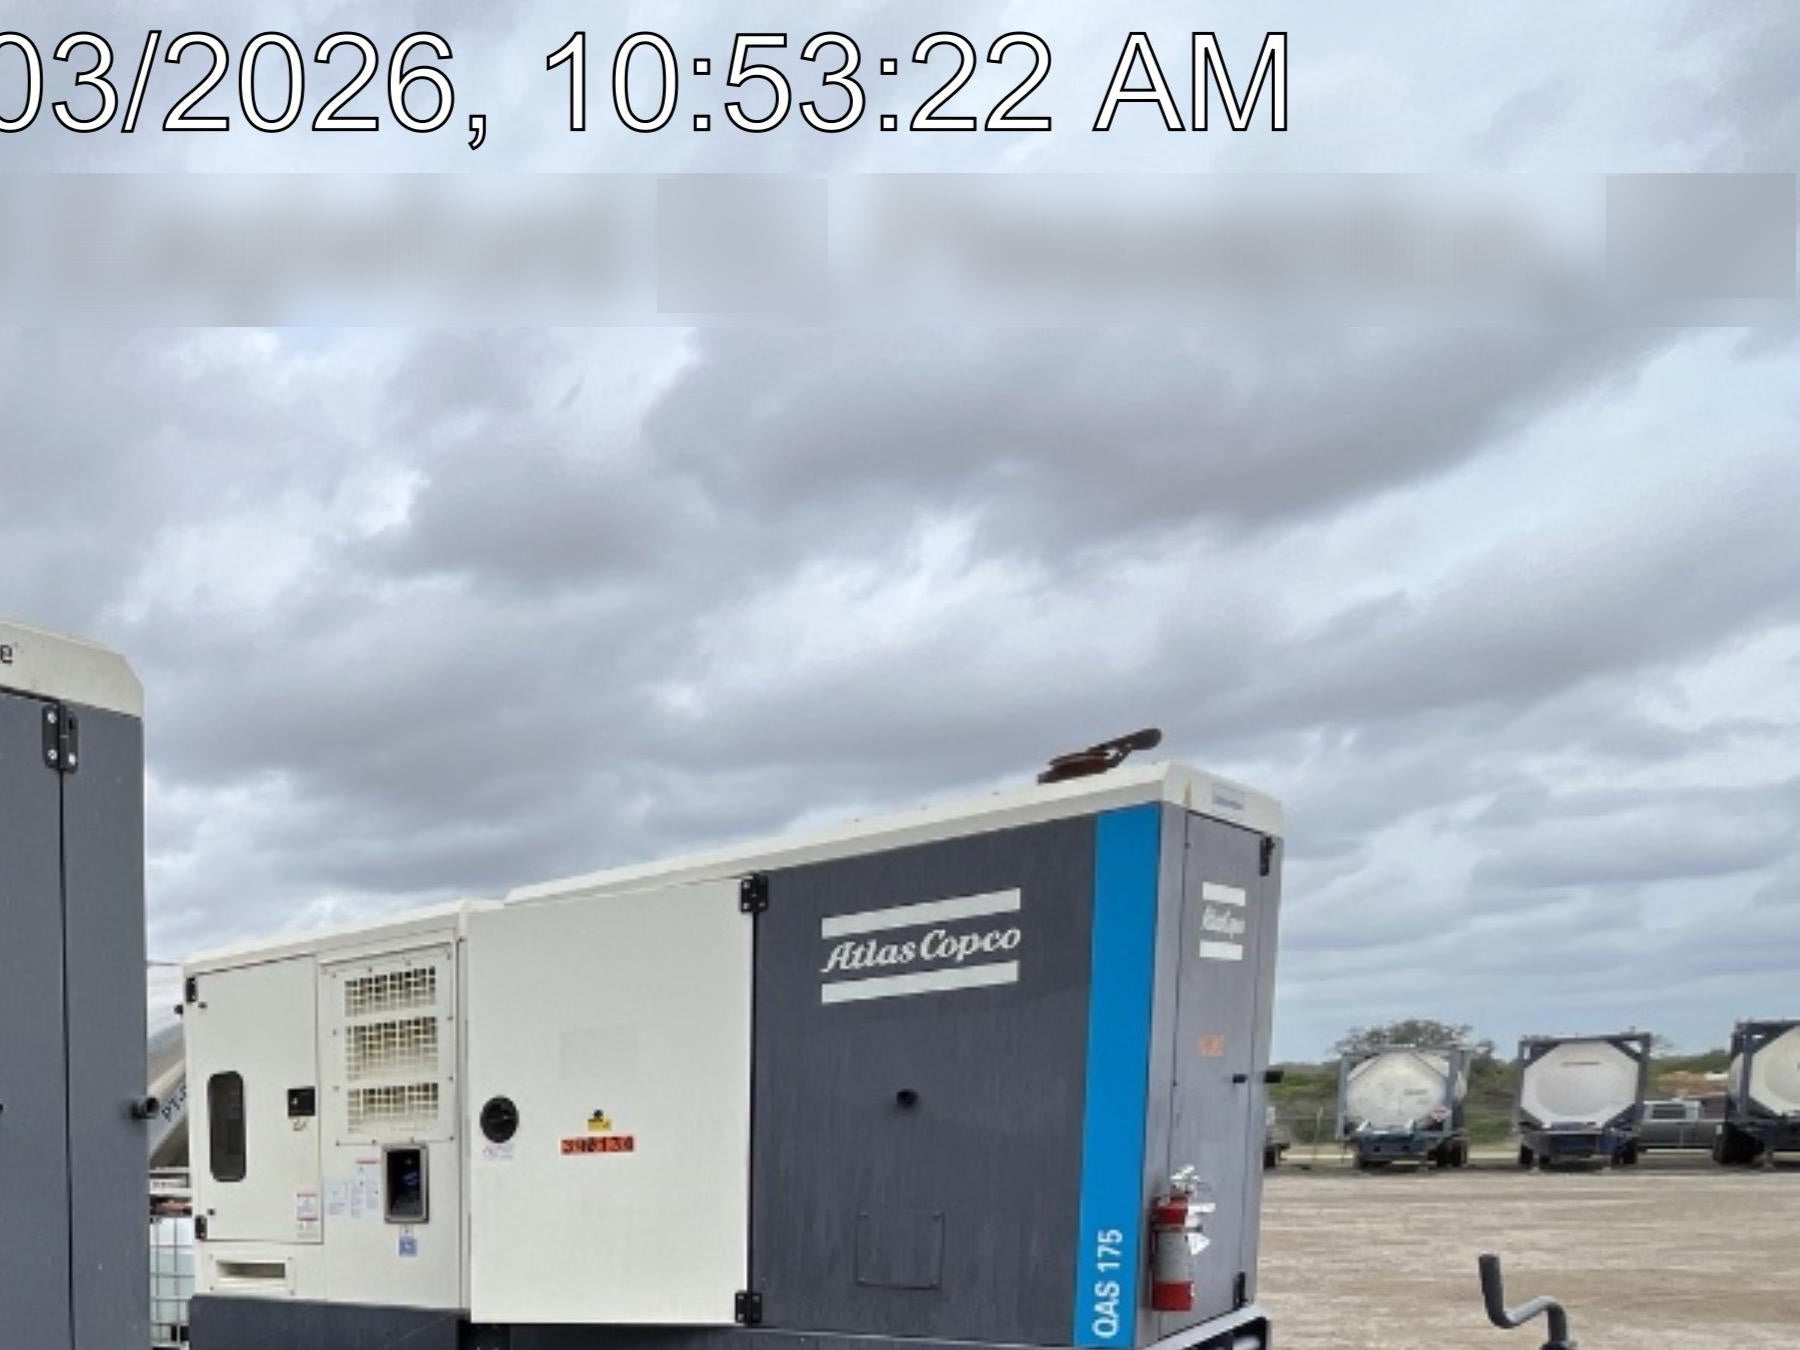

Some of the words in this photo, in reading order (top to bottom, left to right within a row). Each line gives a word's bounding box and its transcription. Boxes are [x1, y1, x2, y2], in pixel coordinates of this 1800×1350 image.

[819, 939, 916, 973] Atlas
[920, 928, 1022, 962] Copco
[1097, 1229, 1123, 1273] 175
[1092, 1280, 1120, 1338] QAS
